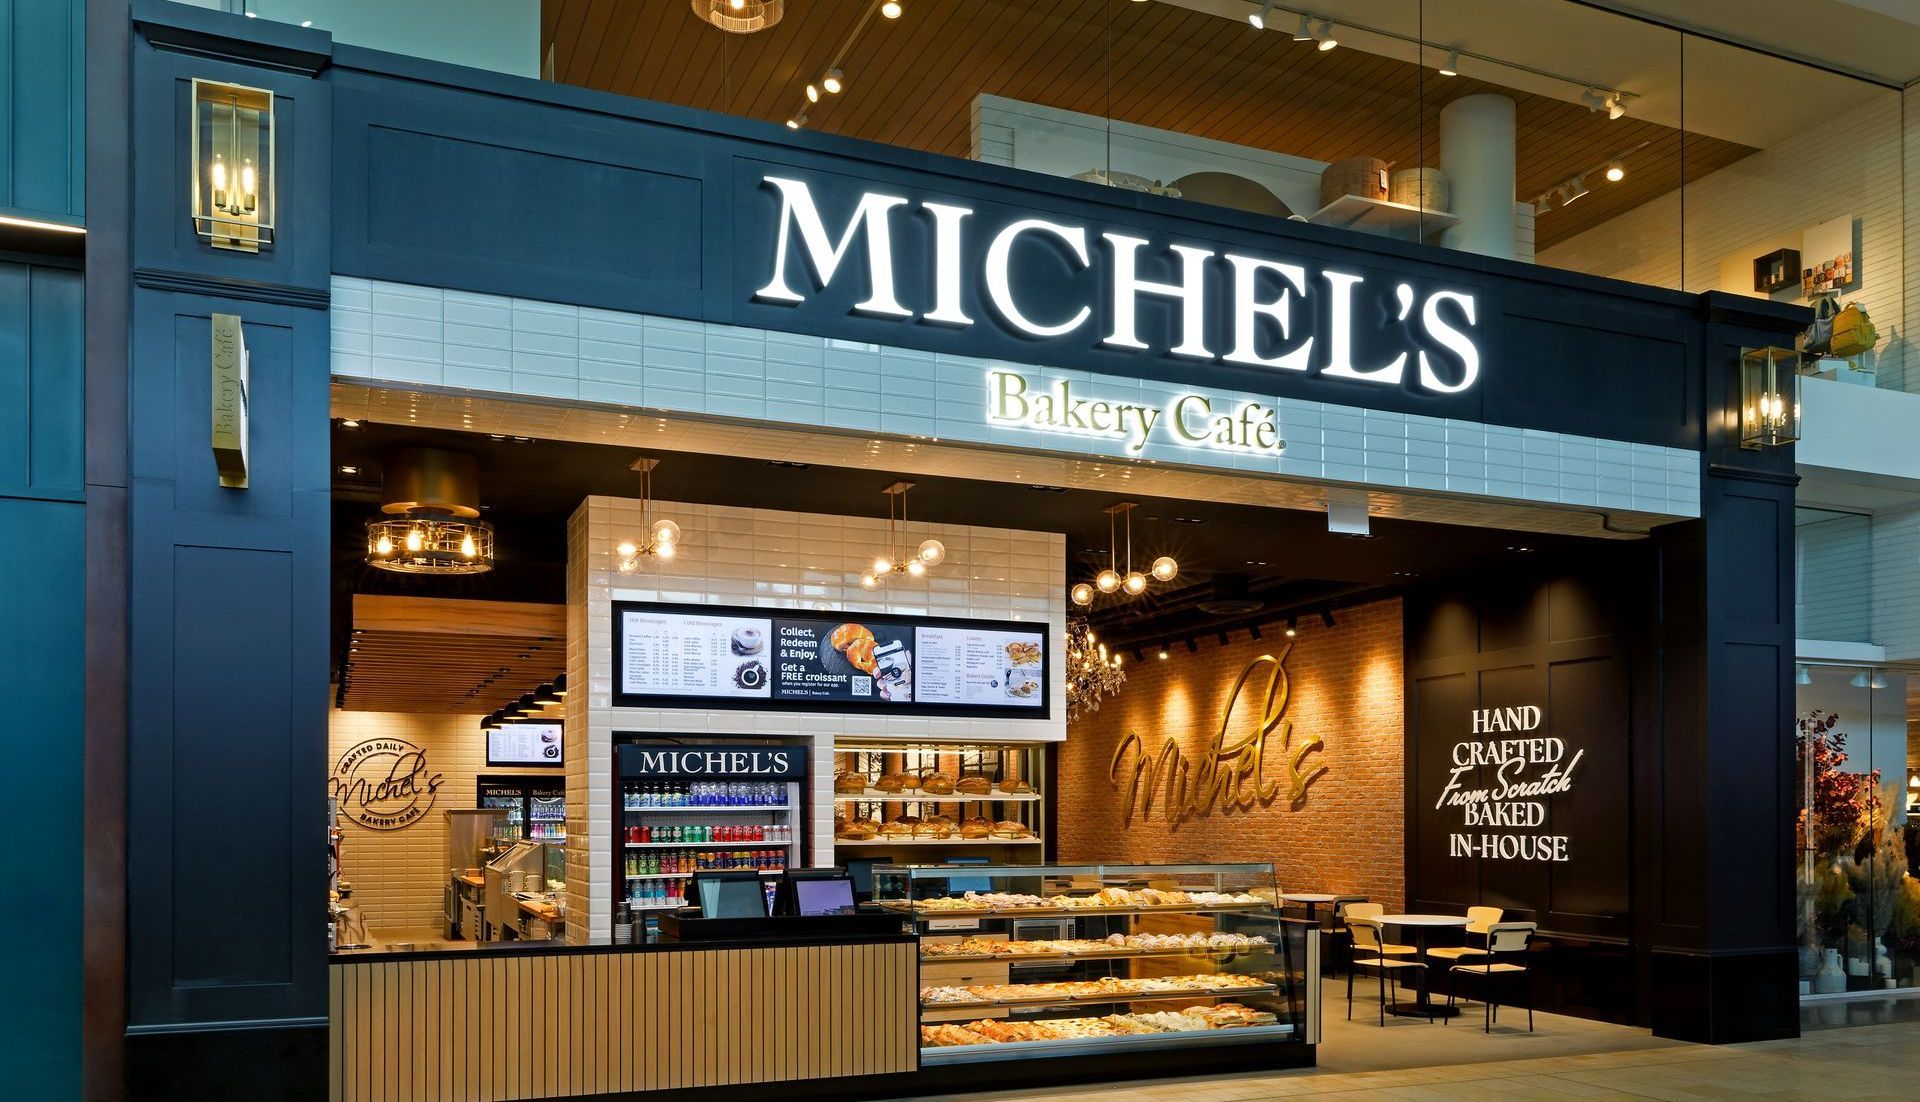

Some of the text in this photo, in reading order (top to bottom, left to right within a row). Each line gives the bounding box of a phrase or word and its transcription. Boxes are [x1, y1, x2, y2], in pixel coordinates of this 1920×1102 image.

[756, 175, 1480, 393] MICHEL'S
[215, 328, 239, 436] Bakery Café
[991, 371, 1160, 450] Bakery
[781, 627, 815, 638] Collect,
[781, 638, 817, 648] Redeem
[780, 649, 818, 660] & Enjoy.
[781, 663, 806, 672] Get a
[781, 672, 847, 682] FREE croissant
[1472, 705, 1541, 734] HAND
[1110, 642, 1327, 828] Michel's
[341, 742, 405, 774] CRAFTED DAILY
[639, 751, 789, 774] MICHEL'S
[1452, 737, 1565, 766] CRAFTED
[328, 748, 445, 807] Michel's
[1435, 749, 1584, 810] From Scratch
[532, 789, 551, 797] Bakery
[360, 812, 397, 826] BAKERY
[1464, 802, 1545, 827] BAKED
[1450, 833, 1570, 862] IN-HOUSE
